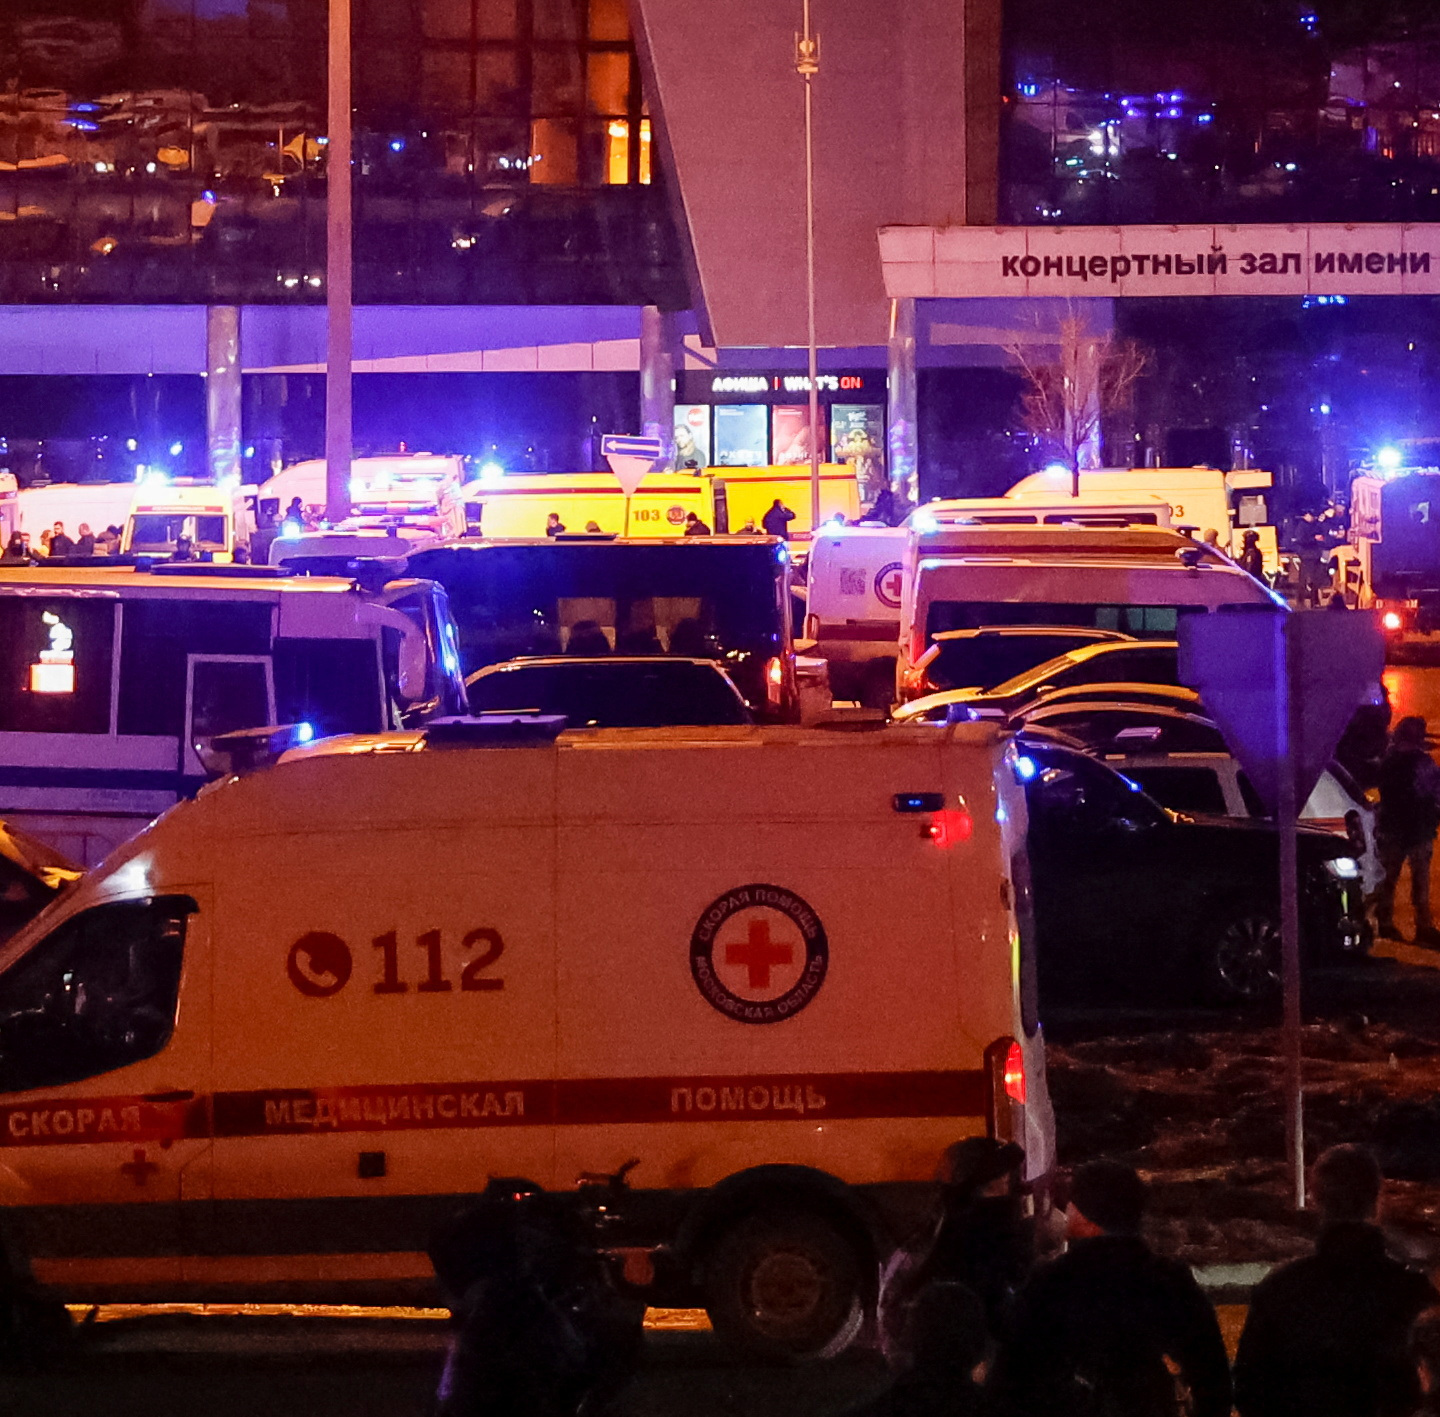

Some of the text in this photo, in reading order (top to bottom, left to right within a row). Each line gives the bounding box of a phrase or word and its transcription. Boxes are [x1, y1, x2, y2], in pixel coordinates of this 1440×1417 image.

[1002, 244, 1228, 283] концертный
[1239, 252, 1301, 275] зал
[1313, 251, 1430, 274] имени
[841, 377, 863, 389] ON
[633, 510, 660, 521] 103
[699, 889, 818, 941] СКОРАЯ ПОМОЩЬ
[372, 927, 504, 994] 112
[8, 1085, 826, 1137] СКОРАЯ МЕДИЦИНСКАЯ ПОМОЩЬ
